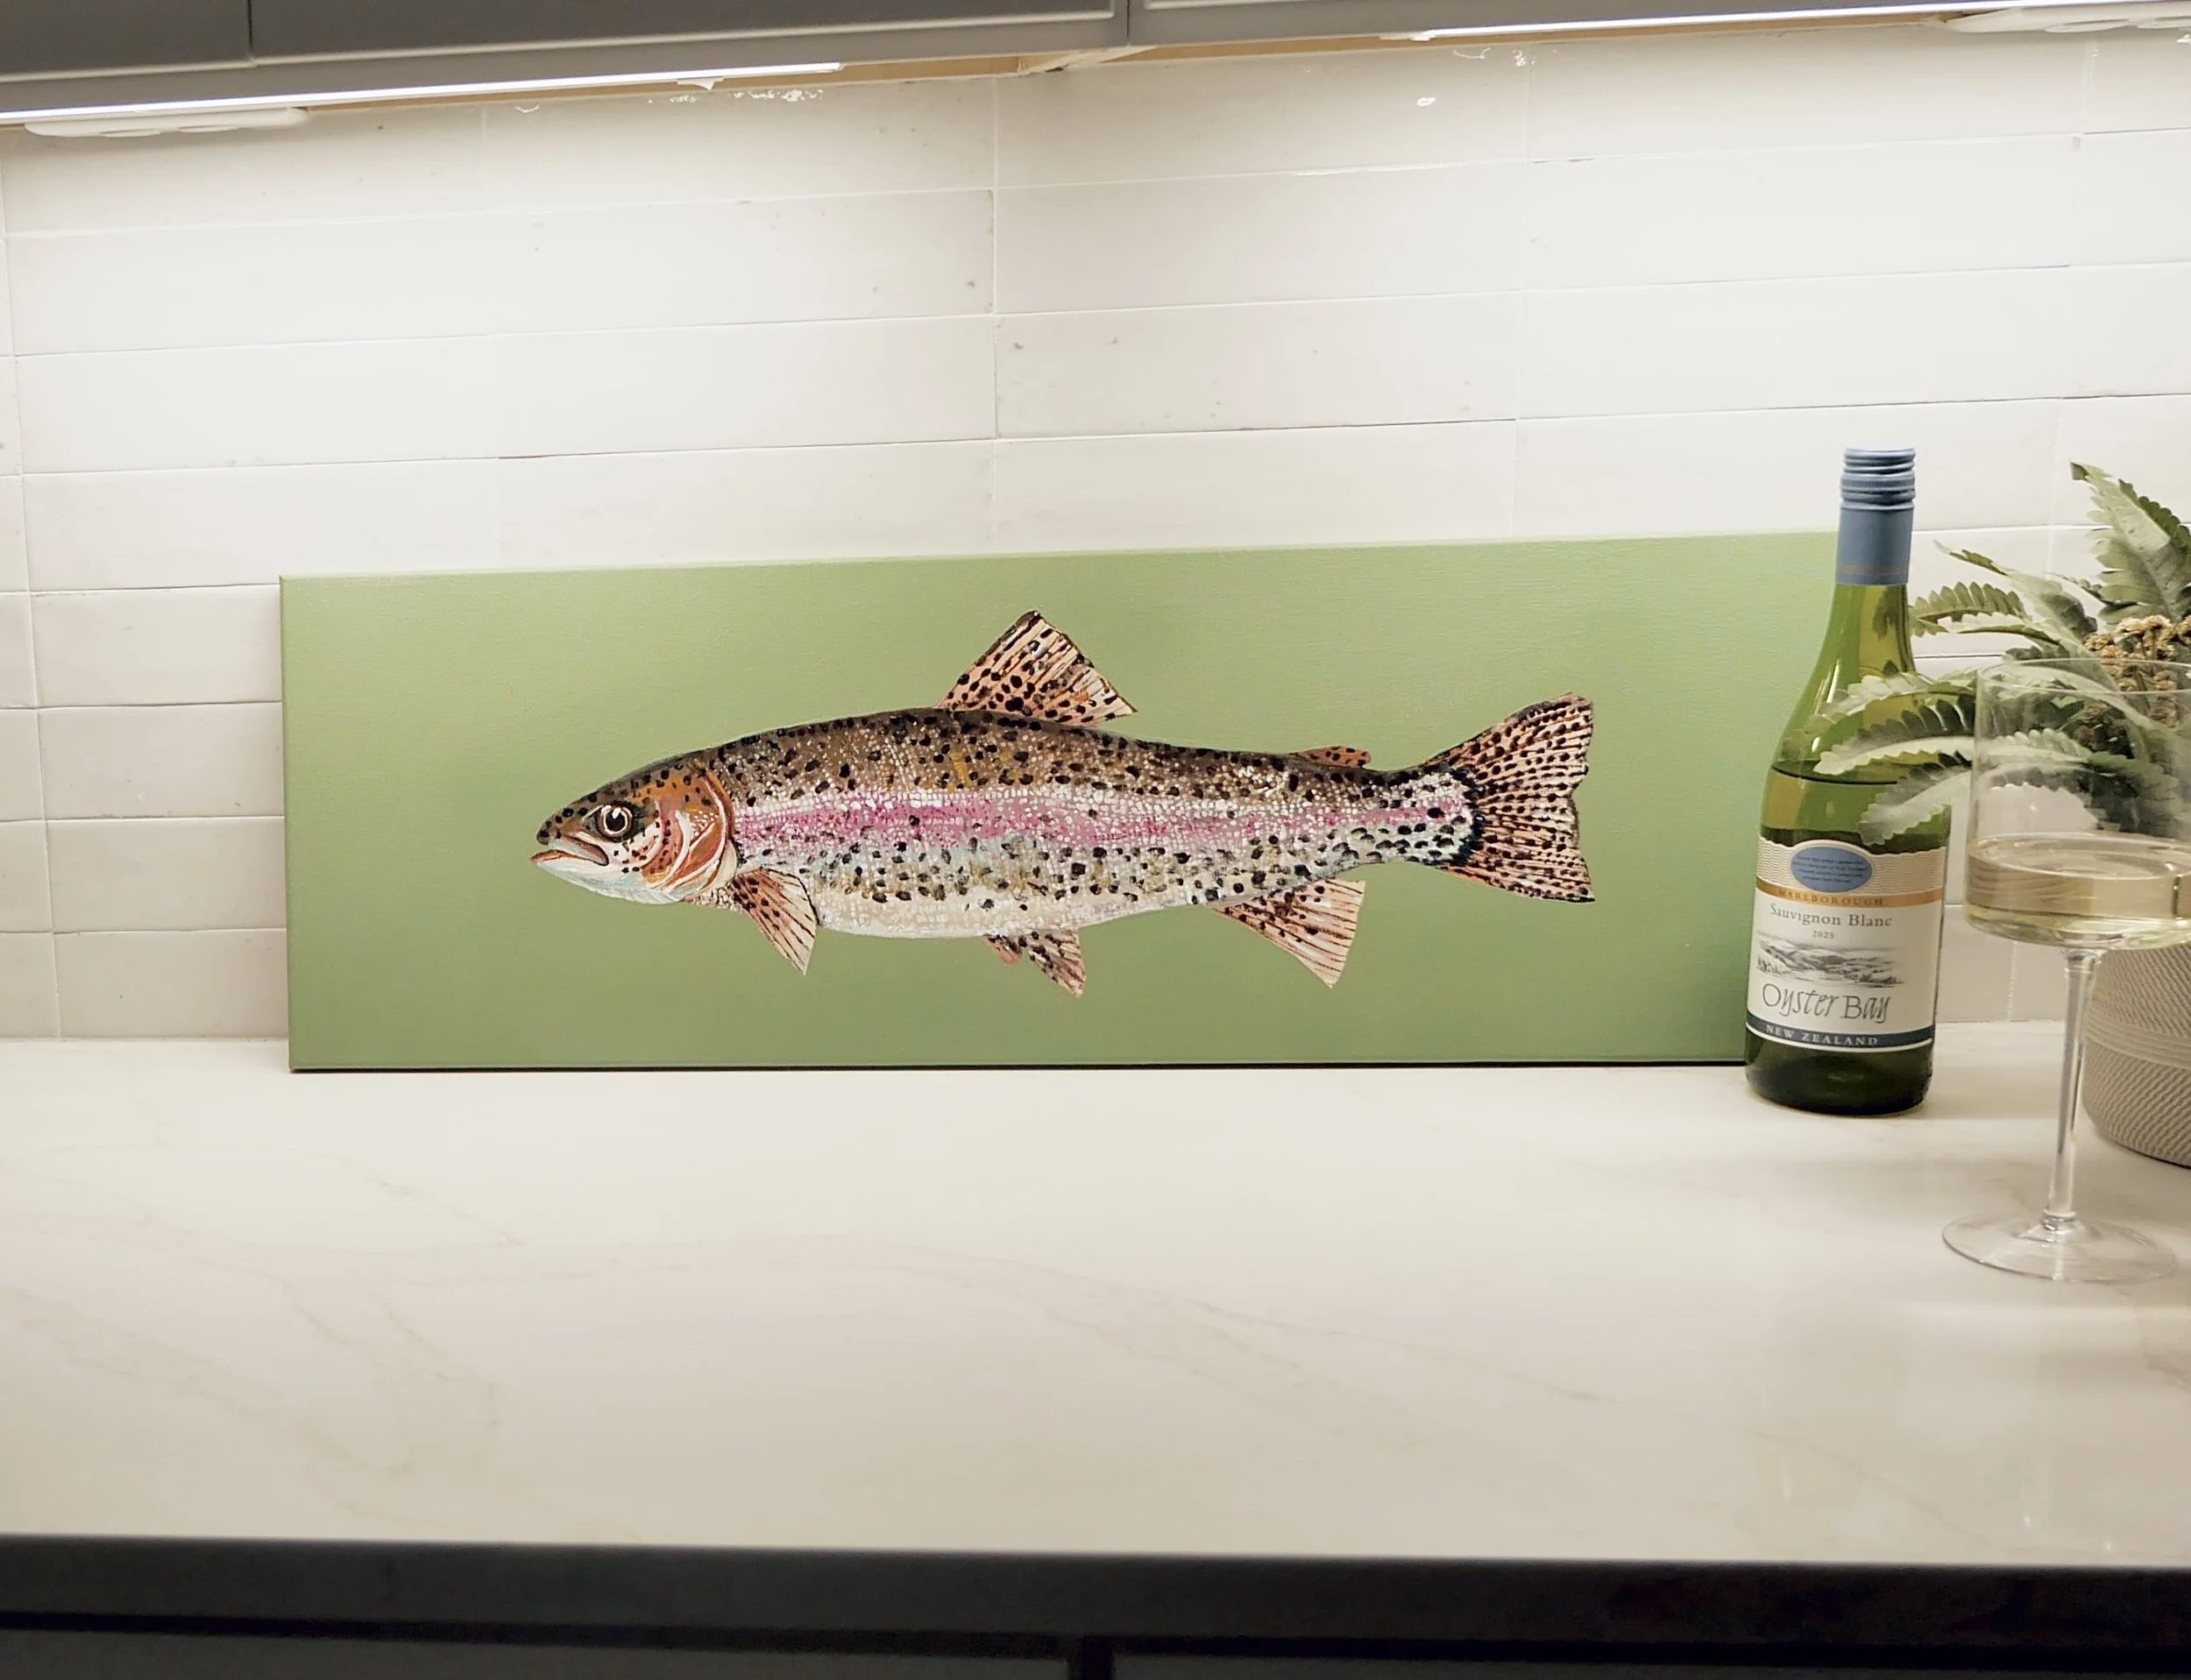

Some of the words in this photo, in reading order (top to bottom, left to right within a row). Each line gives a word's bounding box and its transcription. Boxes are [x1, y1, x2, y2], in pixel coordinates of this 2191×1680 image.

[1779, 889, 1883, 905] MARLBOROUGH
[1770, 903, 1841, 925] Sauvignon
[1848, 913, 1892, 927] Blanc
[1762, 982, 1840, 1017] Oyster
[1840, 995, 1891, 1024] Bay
[1766, 1024, 1795, 1038] NEW
[1801, 1032, 1878, 1046] ZEALAND
